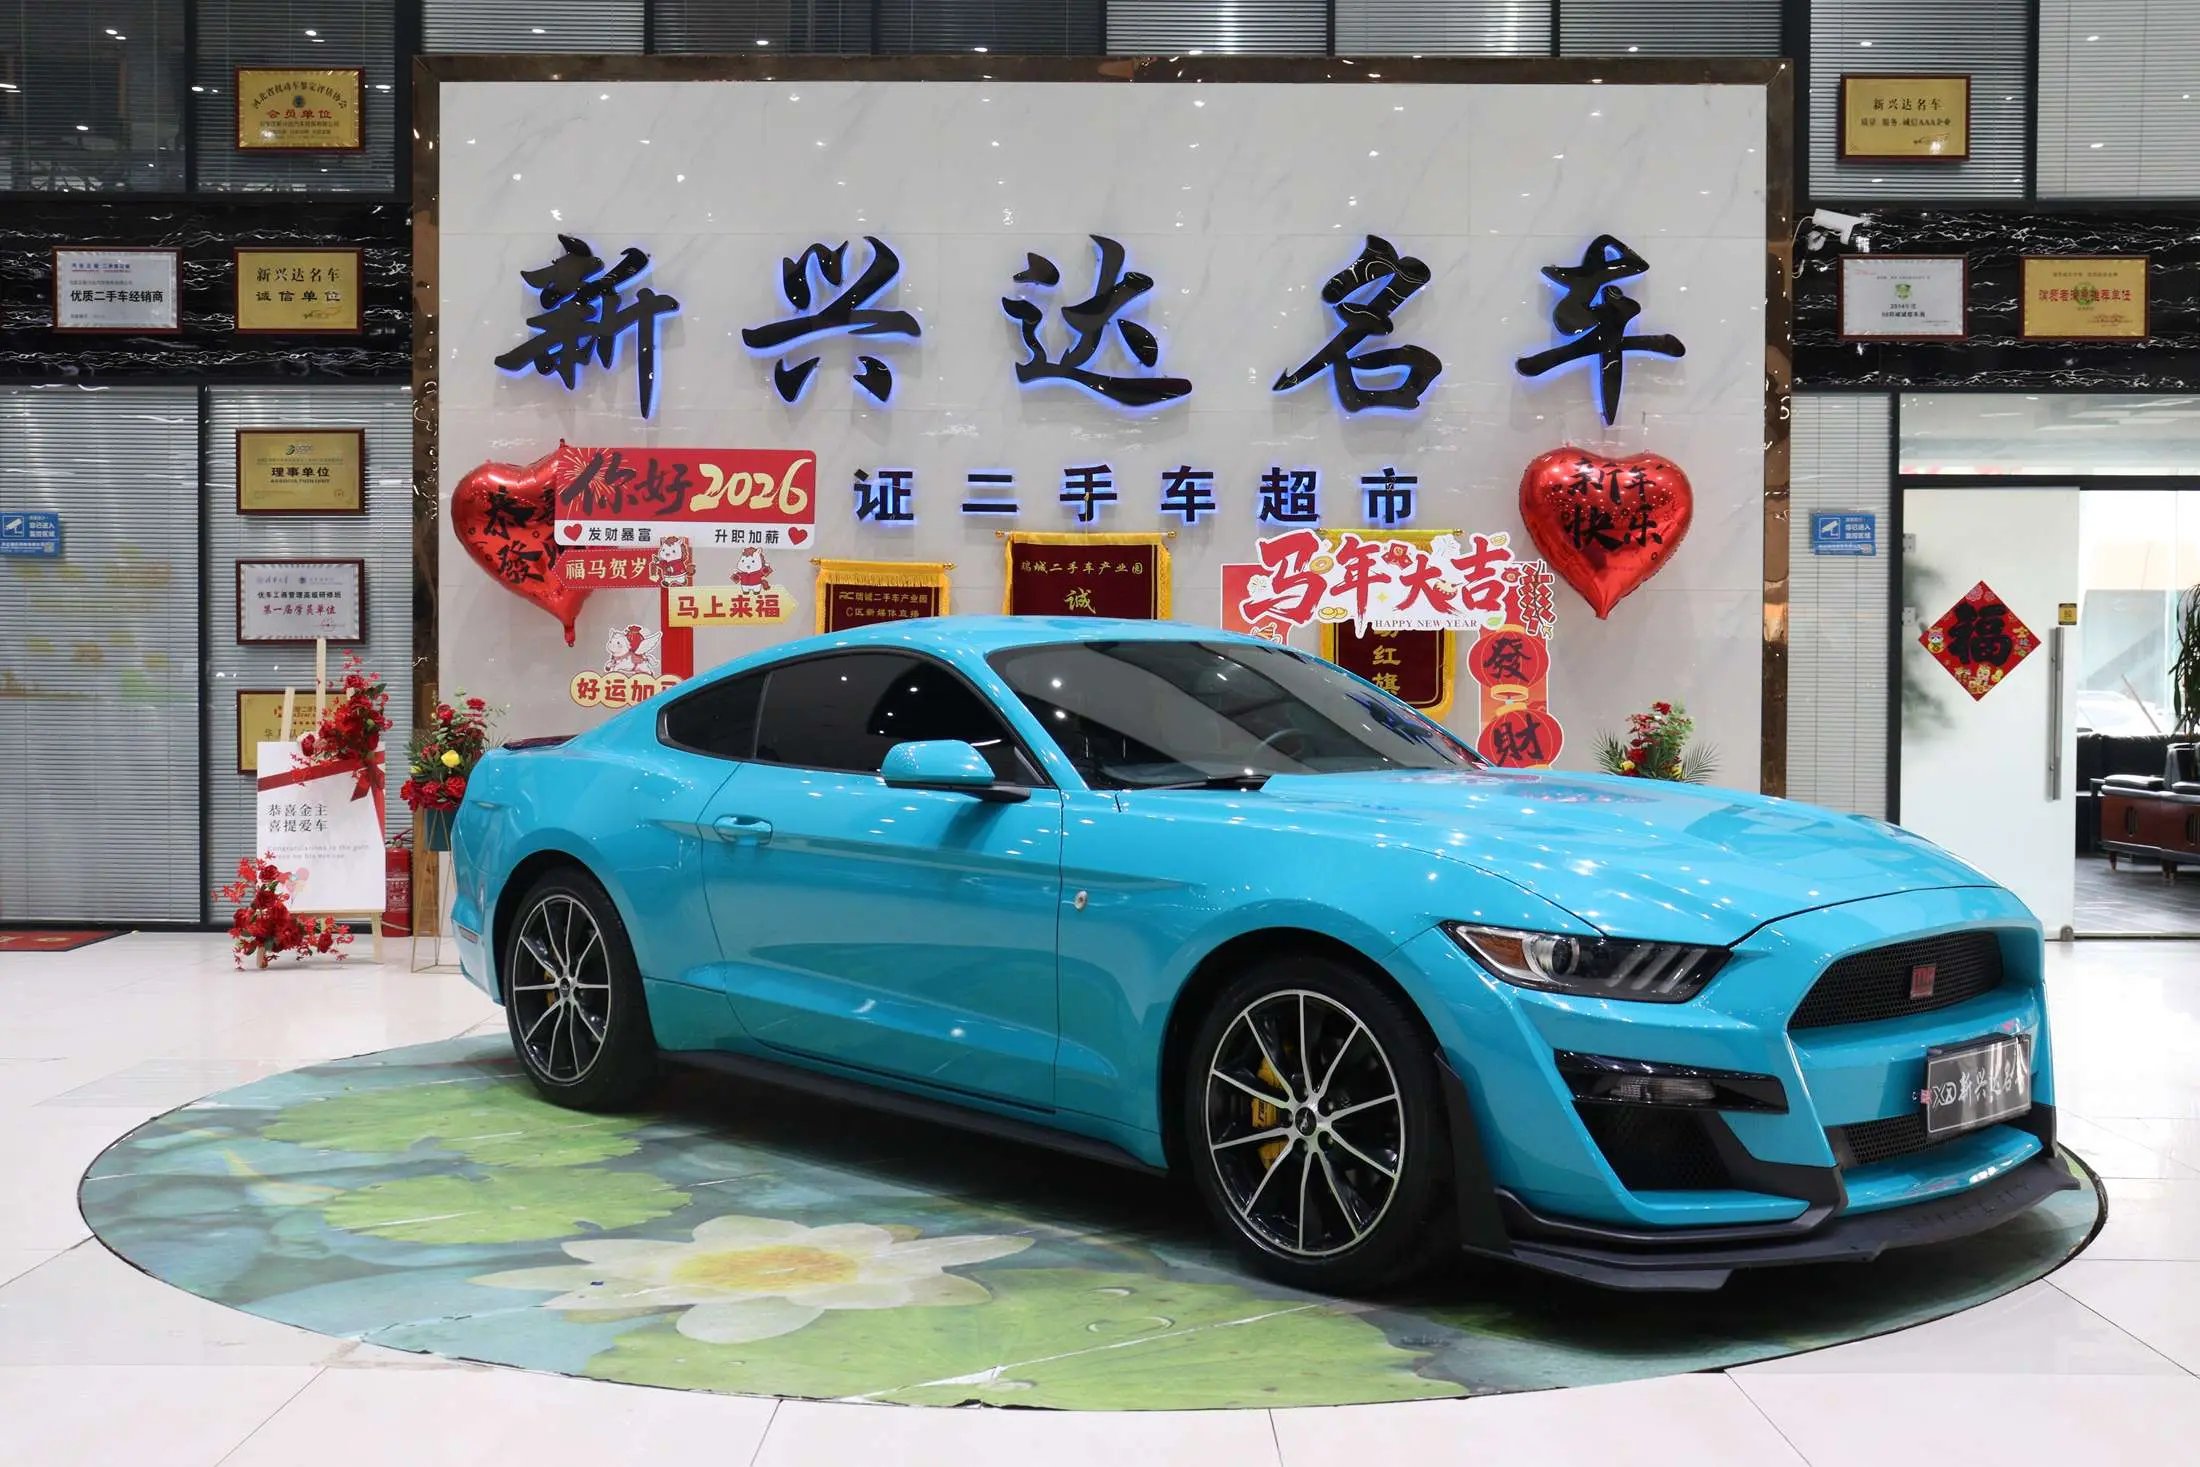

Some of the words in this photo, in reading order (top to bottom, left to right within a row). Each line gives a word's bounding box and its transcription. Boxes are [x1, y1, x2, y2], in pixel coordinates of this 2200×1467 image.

[1873, 98, 1943, 110] 新兴达名车
[266, 109, 332, 119] 会员单位
[256, 267, 341, 282] 新兴达名车
[70, 290, 163, 302] 优质二手车经销商
[256, 290, 341, 302] 诚信单位
[495, 235, 1685, 425] 新兴达名车
[271, 466, 330, 477] 理事单位
[1567, 456, 1663, 505] 新年
[855, 465, 1417, 522] 证二手车超市
[1564, 502, 1663, 551] 快乐
[588, 527, 652, 543] 发财暴富
[714, 528, 780, 545] 升职加薪
[565, 557, 648, 580] 福马贺岁
[1243, 531, 1515, 638] 马年大吉
[676, 594, 781, 619] 马上来福
[1375, 619, 1414, 628] HAPPY
[1416, 619, 1442, 628] NEW
[1446, 619, 1478, 628] YEAR
[1947, 601, 2013, 667] 福
[577, 678, 677, 702] 好运加
[268, 803, 328, 817] 恭喜金主
[269, 819, 329, 832] 喜提爱车
